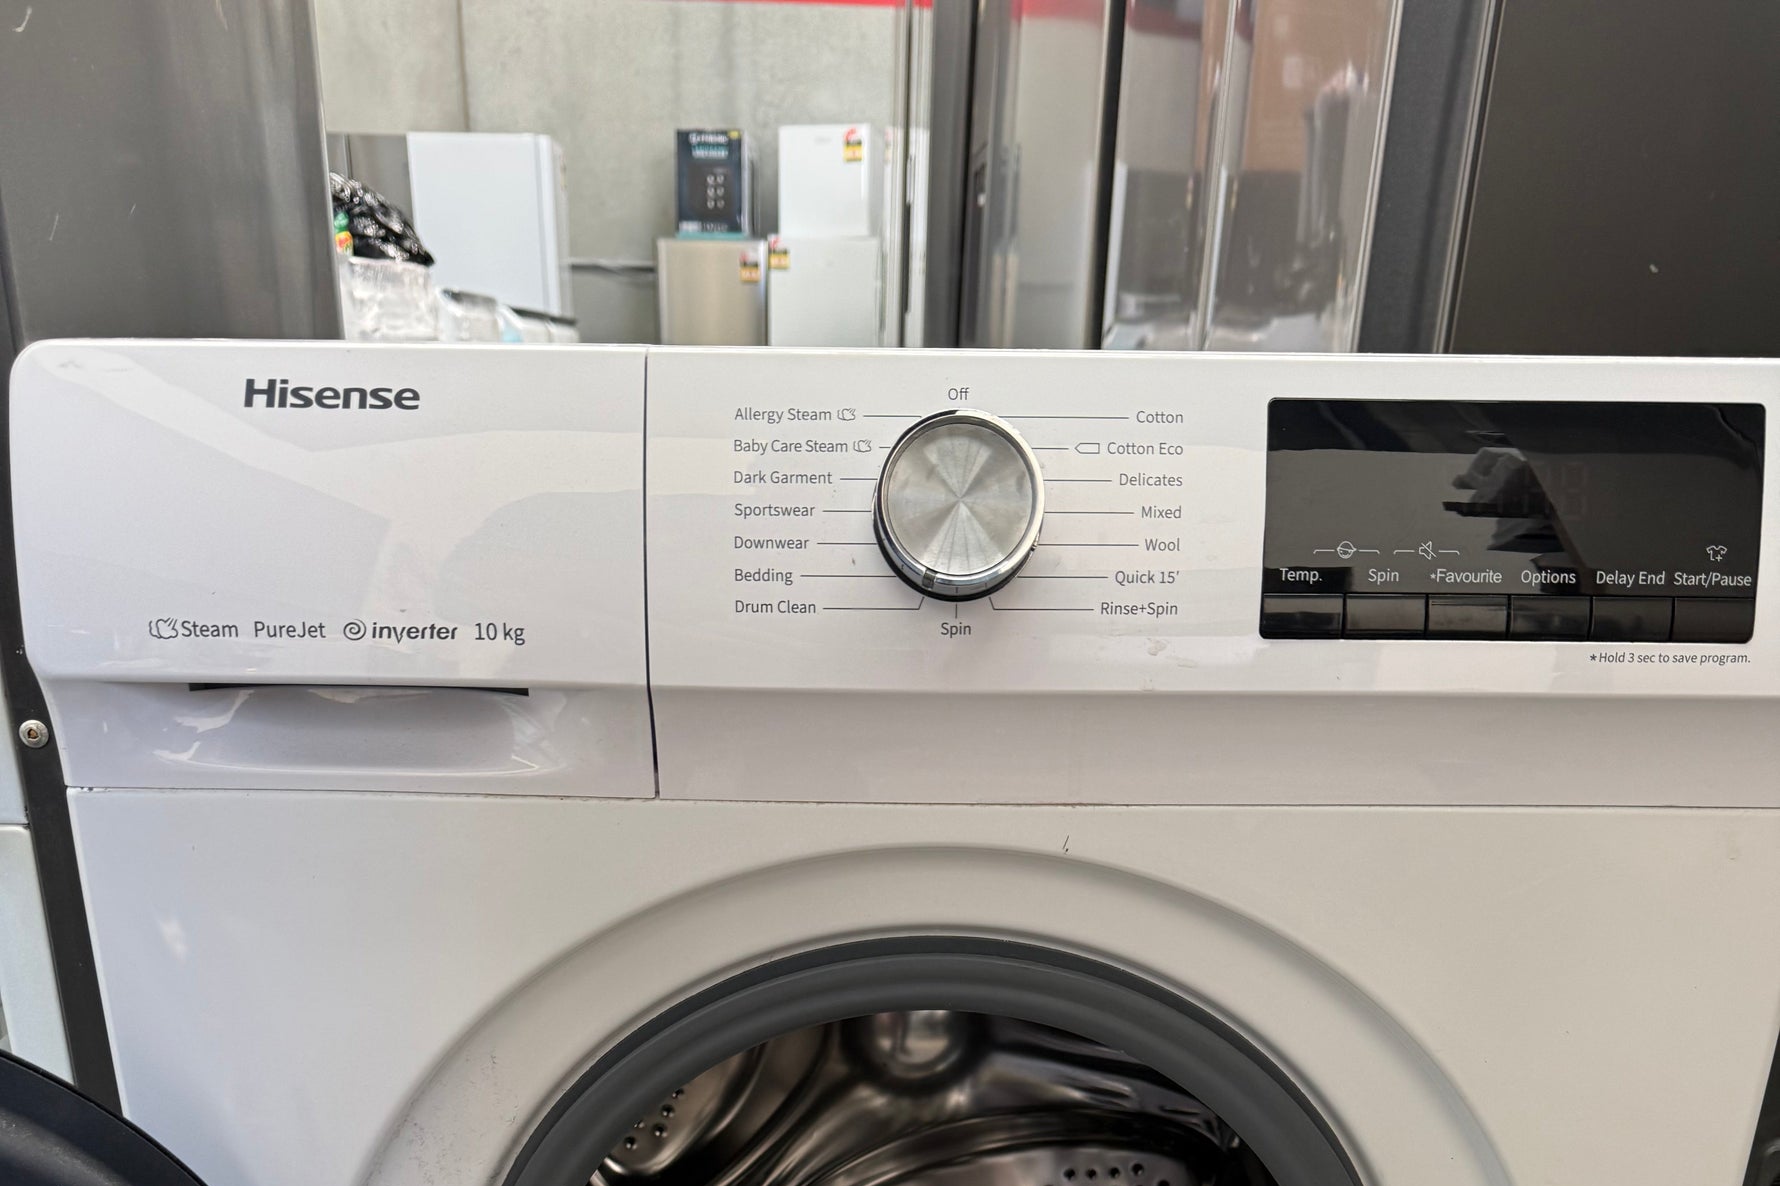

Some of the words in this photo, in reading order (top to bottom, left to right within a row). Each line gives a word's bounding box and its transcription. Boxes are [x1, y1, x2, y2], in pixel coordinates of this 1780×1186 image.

[243, 378, 420, 411] Hisense
[947, 387, 969, 401] Off
[735, 408, 784, 424] Allergy
[788, 408, 832, 421] Steam
[1136, 410, 1183, 424] Cotton
[733, 440, 766, 455] Baby
[770, 440, 802, 453] Care
[805, 440, 848, 453] Steam
[1107, 442, 1155, 455] Cotton
[1159, 442, 1183, 455] Eco
[734, 471, 767, 484] Dark
[771, 472, 832, 485] Garment
[1119, 473, 1183, 487] Delicates
[734, 503, 815, 518] Sportswear
[1141, 505, 1182, 519] Mixed
[734, 536, 809, 550] Downwear
[1145, 538, 1180, 552] Wool
[734, 568, 793, 584] Bedding
[1114, 570, 1154, 585] Quick
[1280, 568, 1323, 585] Temp.
[1368, 568, 1399, 586] Spin
[1521, 569, 1576, 586] Options
[1596, 570, 1635, 588] Delay
[1639, 571, 1665, 585] End
[1673, 571, 1752, 588] Start/Pause
[735, 600, 774, 613] Drum
[777, 600, 817, 614] Clean
[1100, 601, 1178, 617] Rinse+Spin
[181, 620, 239, 640] Steam
[253, 620, 326, 640] PureJet
[371, 621, 458, 643] inverter
[474, 622, 497, 642] 10
[501, 622, 526, 646] kg
[940, 622, 971, 638] Spin
[1627, 652, 1635, 663] 3
[1637, 654, 1656, 663] sec
[1658, 653, 1670, 663] to
[1672, 654, 1698, 663] save
[1700, 653, 1751, 666] program.
